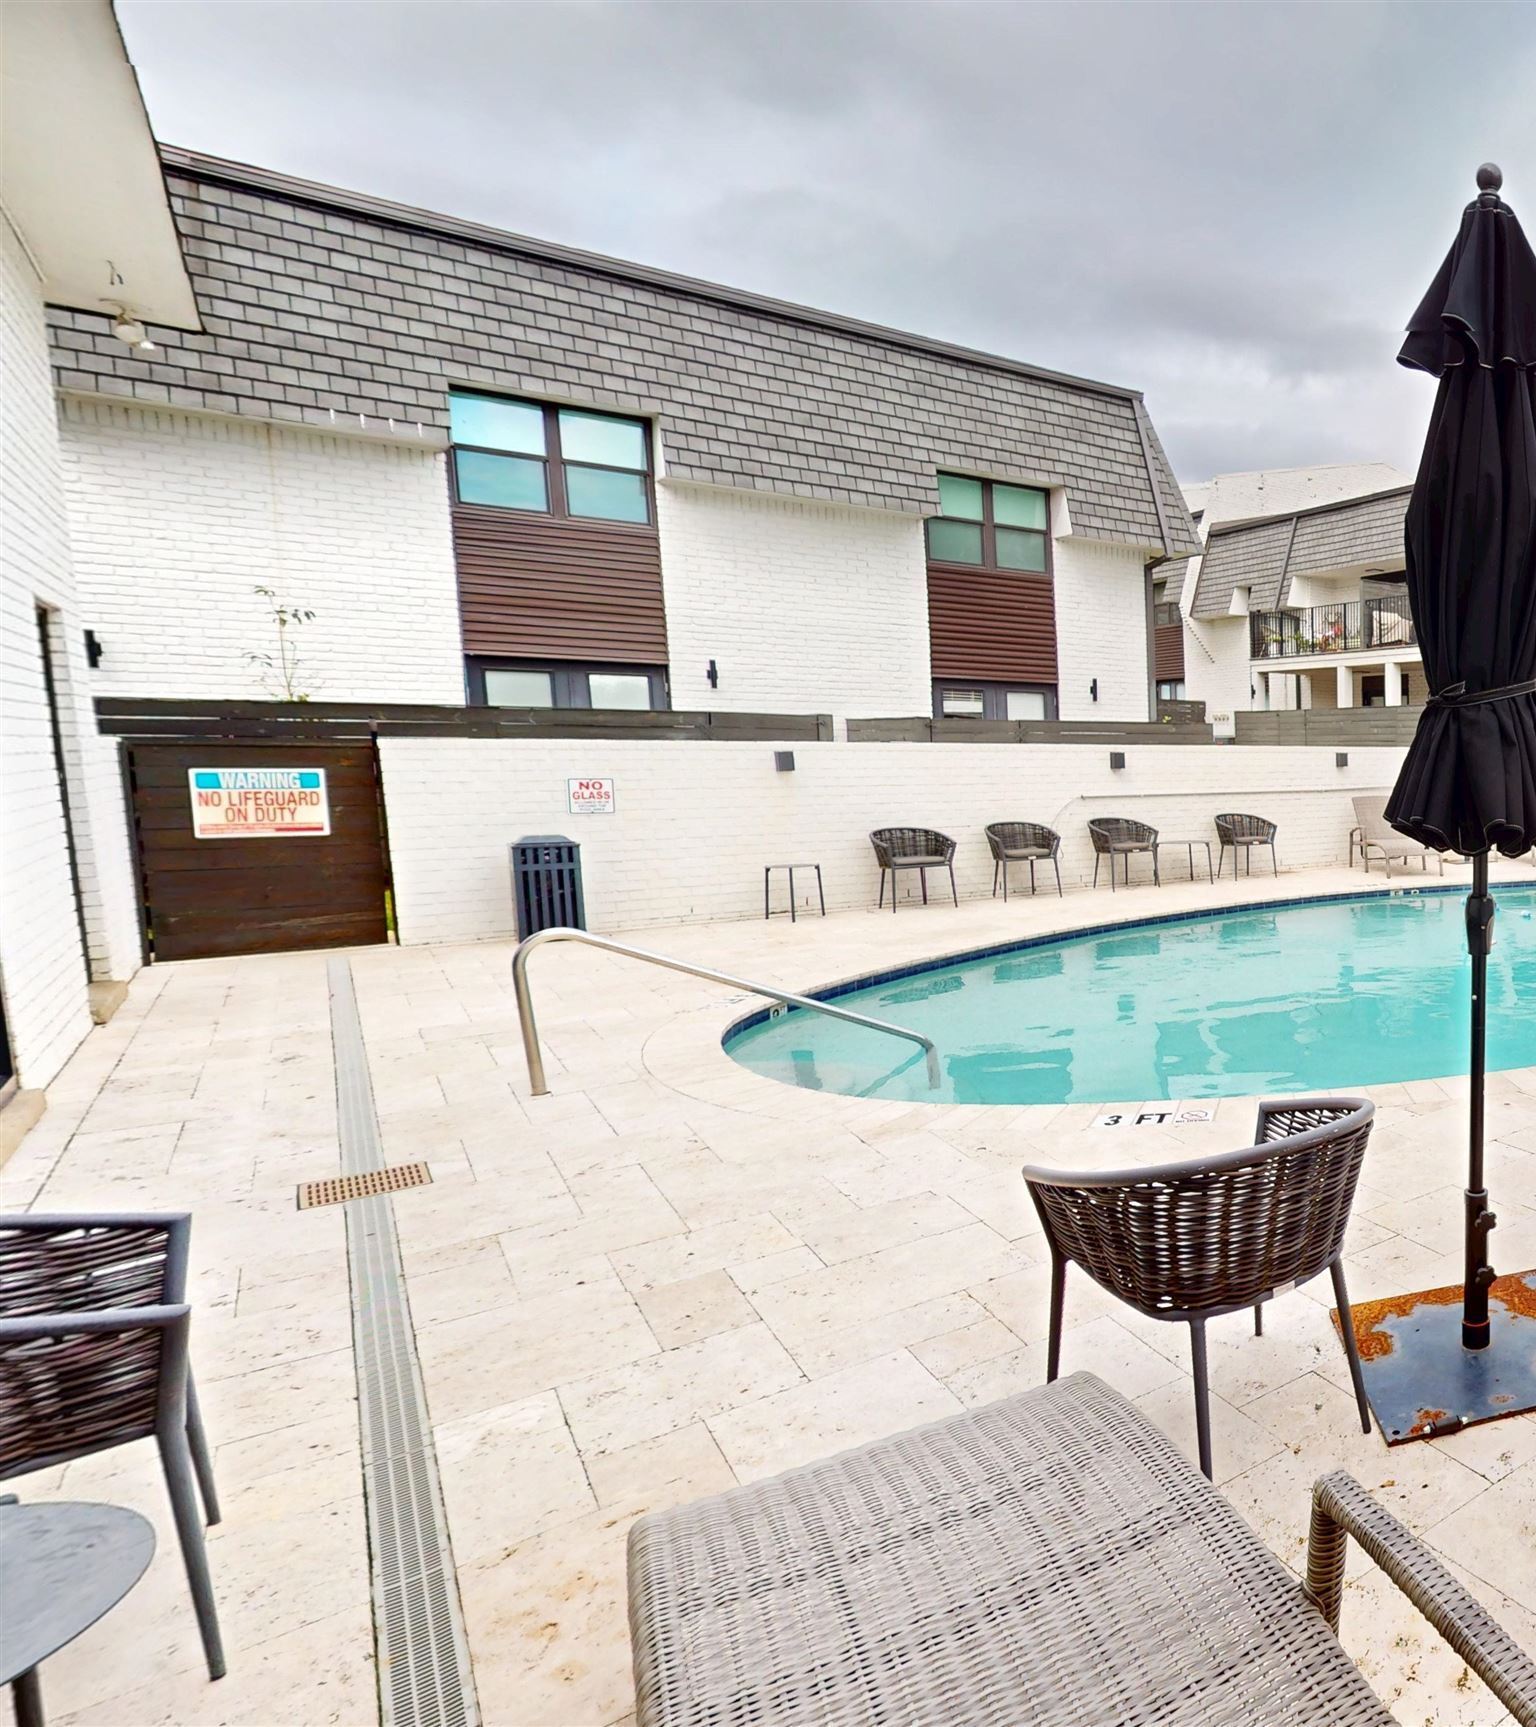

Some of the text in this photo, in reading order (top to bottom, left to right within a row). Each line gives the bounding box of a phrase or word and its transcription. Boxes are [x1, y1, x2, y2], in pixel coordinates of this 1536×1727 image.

[221, 772, 301, 789] WARNING
[579, 781, 603, 790] NO
[197, 791, 320, 806] NO LIFEGUARD
[572, 791, 610, 800] GLASS
[225, 807, 297, 822] ON DUTY
[1104, 1115, 1122, 1126] 3
[1135, 1112, 1173, 1125] FT
